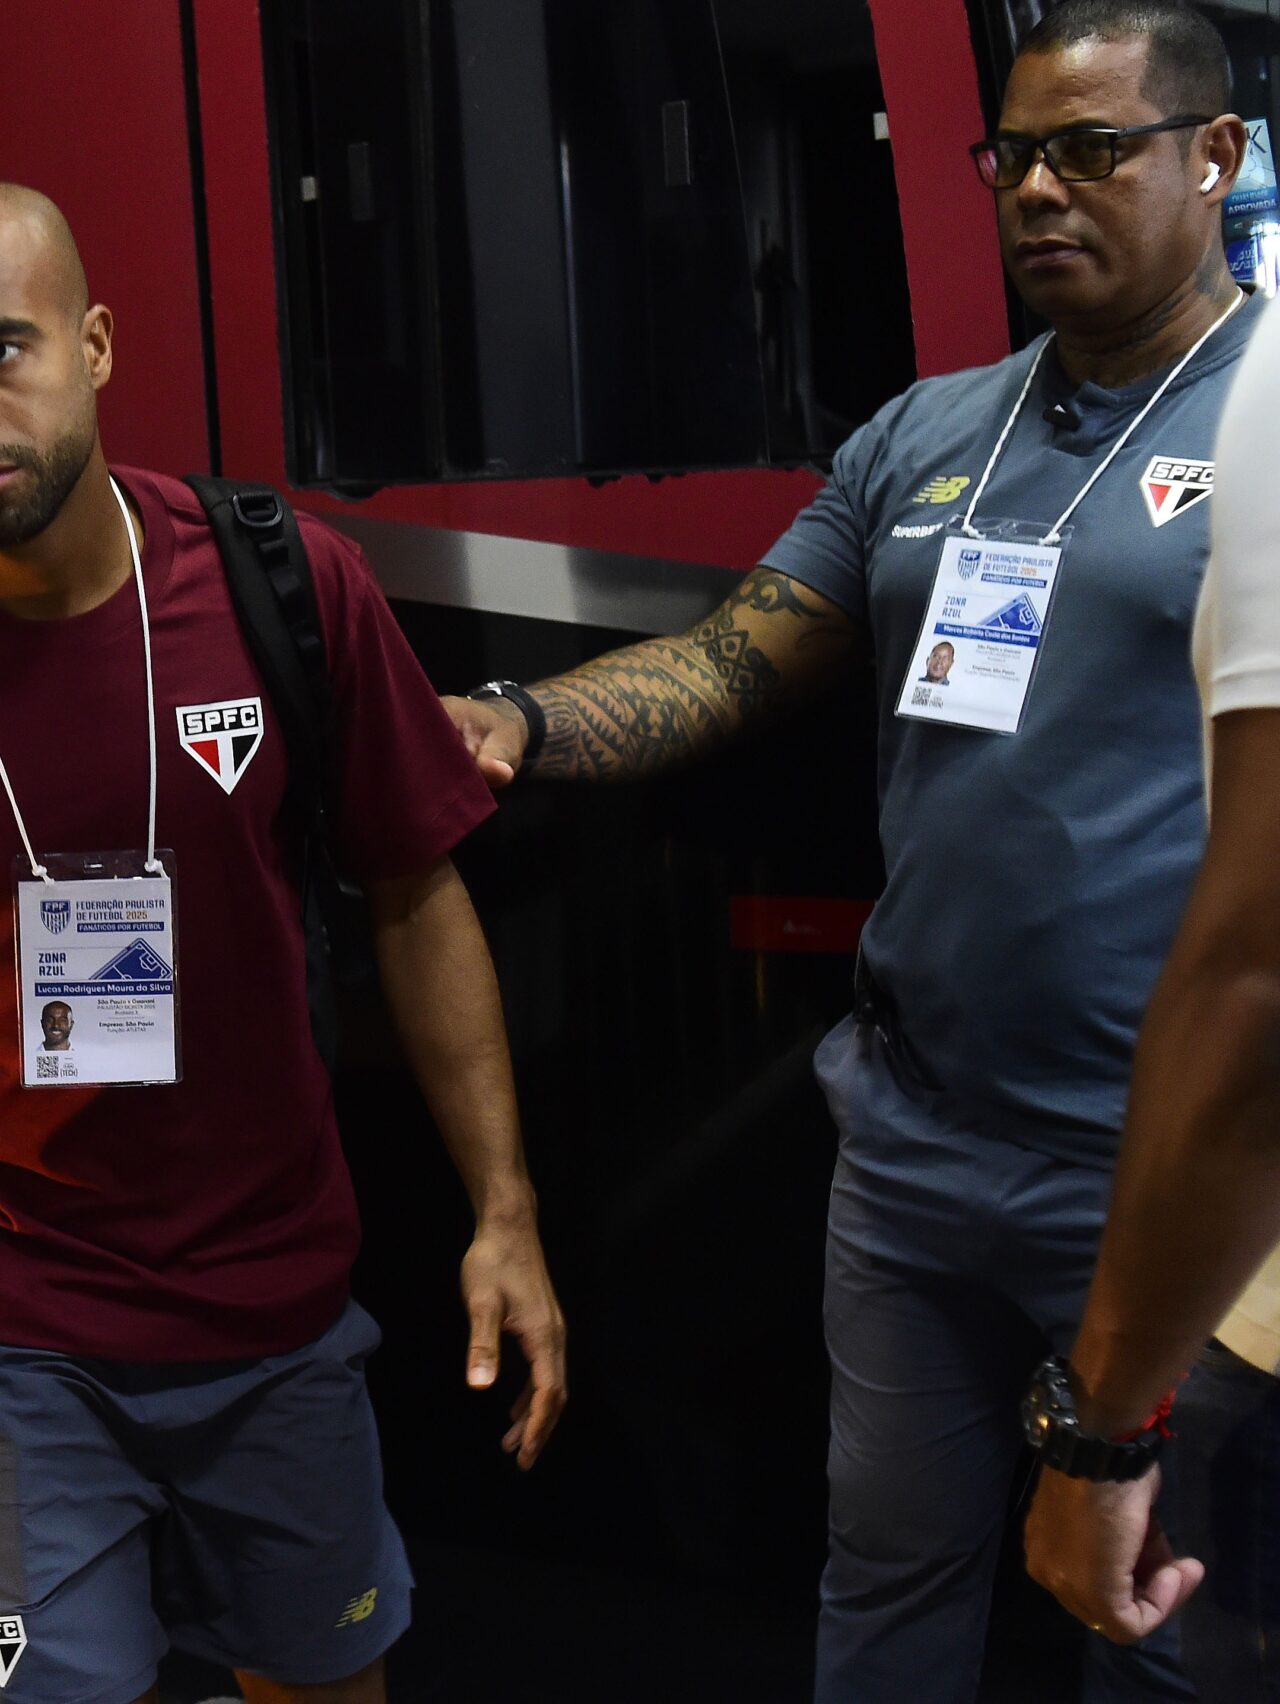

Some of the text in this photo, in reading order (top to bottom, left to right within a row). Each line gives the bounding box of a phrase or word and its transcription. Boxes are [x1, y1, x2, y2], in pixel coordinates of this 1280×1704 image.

[1228, 199, 1276, 214] APROVADA
[1151, 462, 1215, 483] SPFC
[945, 596, 966, 607] ZONA
[942, 607, 962, 618] AZUL
[186, 706, 256, 734] SPFC
[45, 902, 66, 911] FPF
[76, 899, 165, 912] FEDERAÇÃO PAULISTA
[76, 911, 148, 920] DE FUTEBOL 2025
[79, 922, 161, 932] FANÁTICOS POR FUTEBOL
[38, 952, 66, 963] ZONA
[39, 966, 65, 976] AZUL
[37, 983, 171, 994] Lucas Rodrigues Moura da Silva
